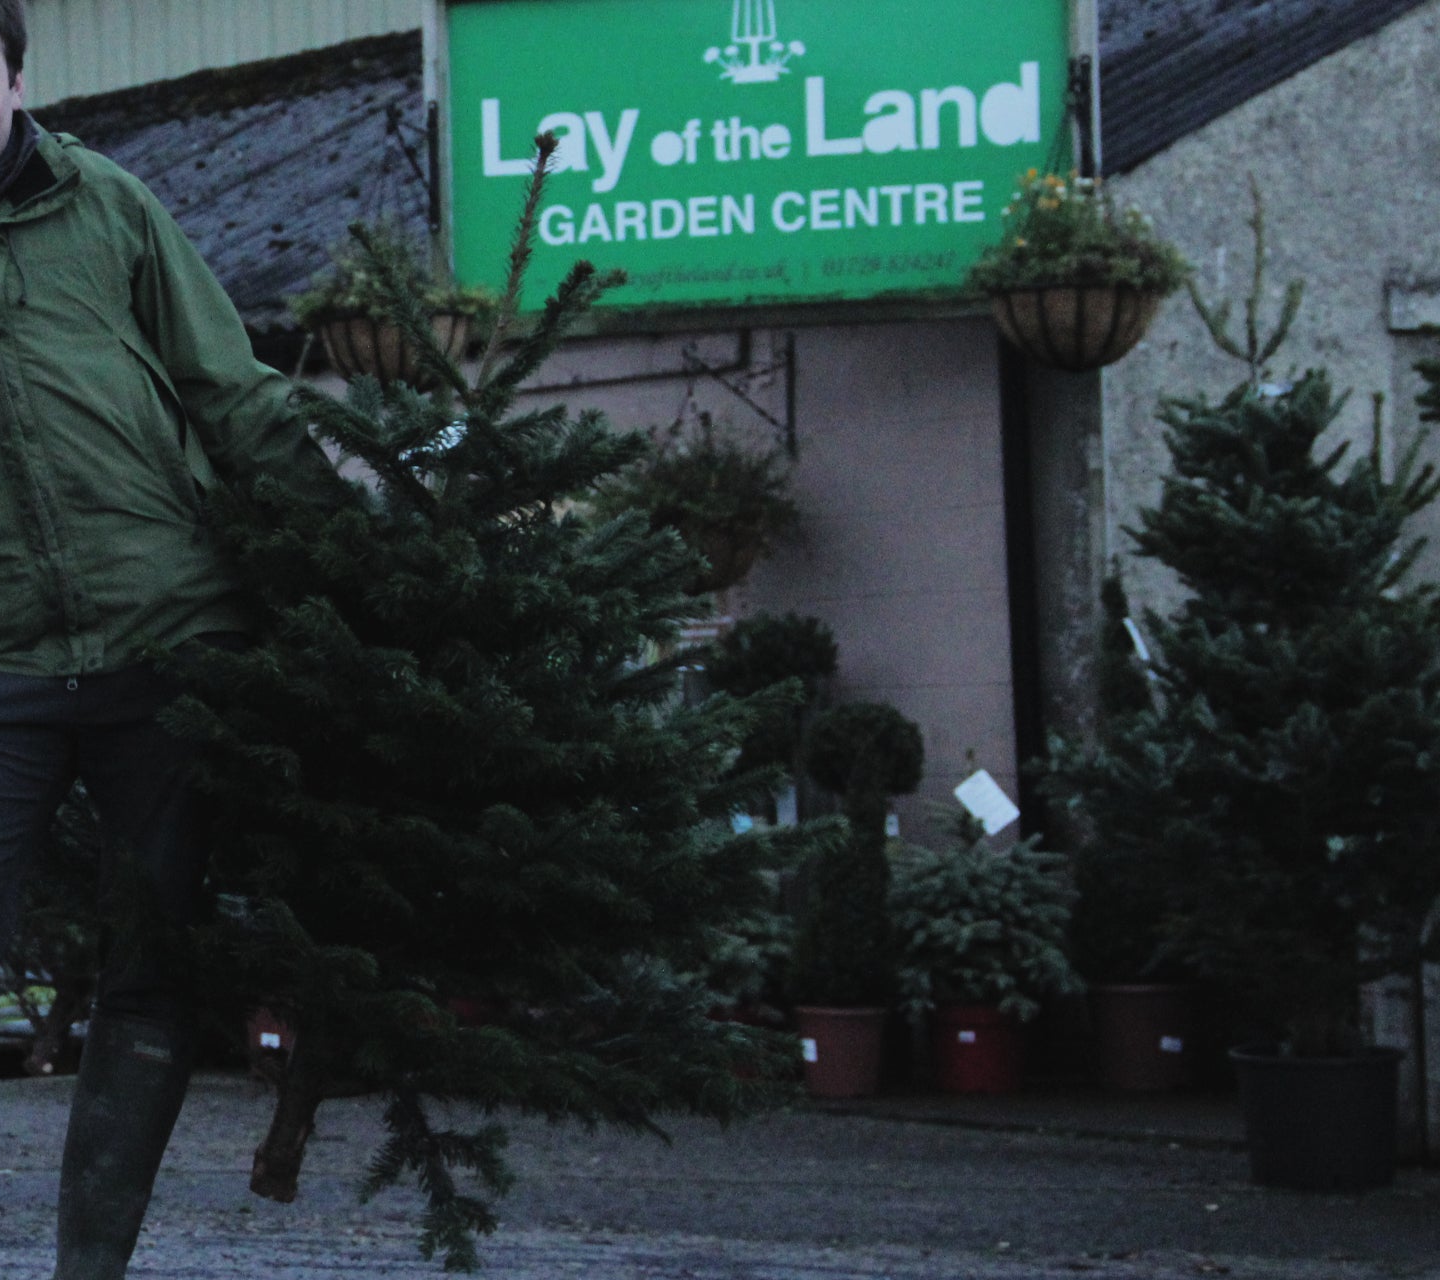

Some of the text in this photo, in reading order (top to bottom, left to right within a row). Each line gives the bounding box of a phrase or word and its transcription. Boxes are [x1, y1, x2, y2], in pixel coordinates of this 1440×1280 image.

[481, 61, 1041, 193] Lay of the Land
[537, 181, 985, 245] GARDEN CENTRE
